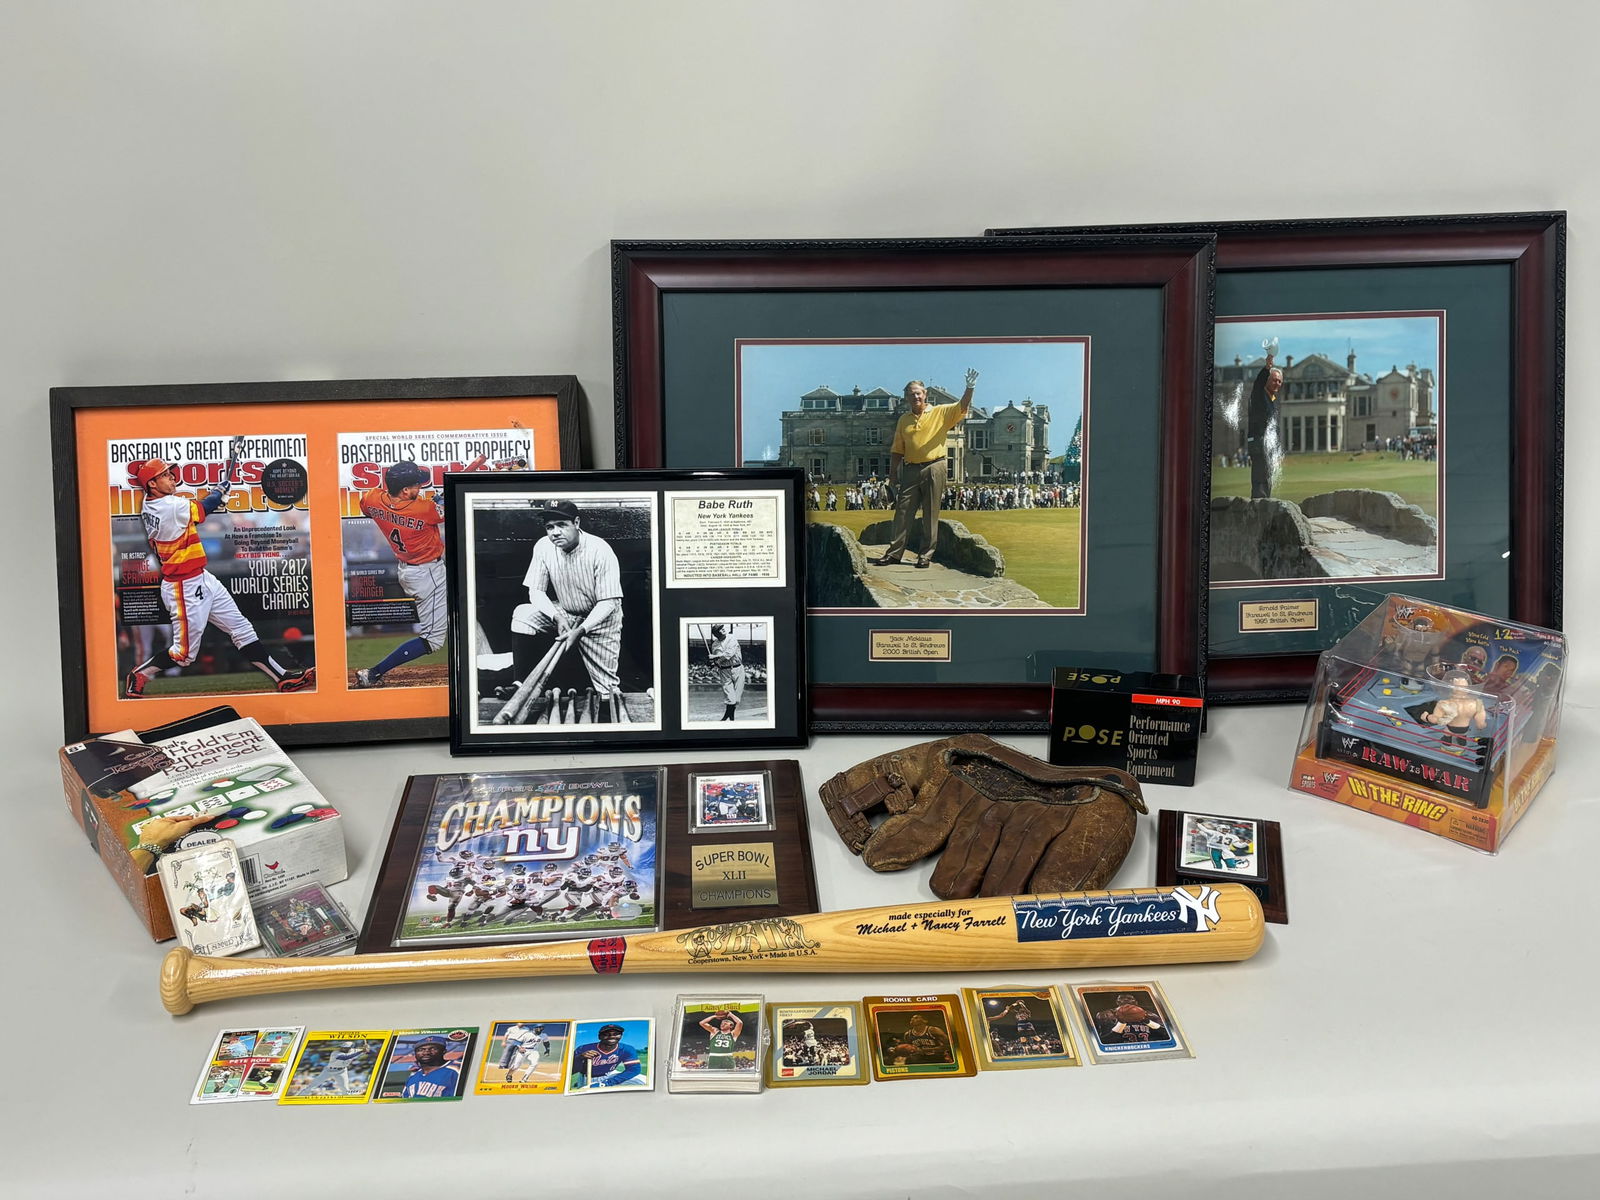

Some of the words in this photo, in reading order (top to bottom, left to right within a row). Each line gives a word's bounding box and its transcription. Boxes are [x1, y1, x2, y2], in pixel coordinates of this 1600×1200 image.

[111, 442, 181, 463] BASEBALL'S
[186, 441, 223, 460] GREAT
[342, 443, 415, 463] BASEBALL'S
[421, 442, 460, 462] GREAT
[466, 440, 530, 460] PROPHECY
[698, 501, 725, 509] Babe
[728, 500, 753, 508] Ruth
[367, 506, 424, 530] SPRINGER
[390, 528, 407, 552] 4
[248, 560, 277, 576] YOUR
[281, 558, 307, 575] 2017
[195, 584, 204, 600] 4
[231, 577, 269, 594] WORLD
[273, 576, 308, 592] SERIES
[262, 592, 309, 610] CHAMPS
[1130, 715, 1191, 732] Performance
[1128, 730, 1169, 746] Oriented
[148, 735, 265, 771] Tournament
[162, 753, 222, 776] Poker
[227, 744, 265, 759] Set
[1126, 745, 1158, 761] Sports
[1127, 761, 1175, 778] Equipment
[1362, 746, 1410, 773] RAW
[1410, 765, 1420, 774] IS
[1421, 763, 1472, 792] WAR
[568, 782, 614, 790] BOWL
[1348, 776, 1368, 797] IN
[1370, 784, 1401, 807] THE
[1403, 797, 1447, 820] RING
[437, 794, 643, 851] CHAMPIONS
[186, 839, 216, 848] DEALER
[1216, 836, 1232, 846] 13
[695, 851, 735, 870] SUPER
[738, 851, 770, 867] BOWL
[722, 871, 746, 880] XLII
[699, 889, 771, 901] CHAMPIONS
[889, 911, 912, 921] made
[914, 909, 954, 921] especially
[957, 908, 972, 919] for
[1019, 909, 1058, 929] New
[1060, 907, 1102, 939] York
[1105, 904, 1176, 936] Yankees
[1170, 885, 1222, 931] NY
[855, 920, 907, 936] Michael
[921, 917, 959, 933] Nancy
[962, 915, 1007, 929] Farrell
[688, 957, 731, 966] Cooperstown,
[700, 1004, 721, 1012] Larry
